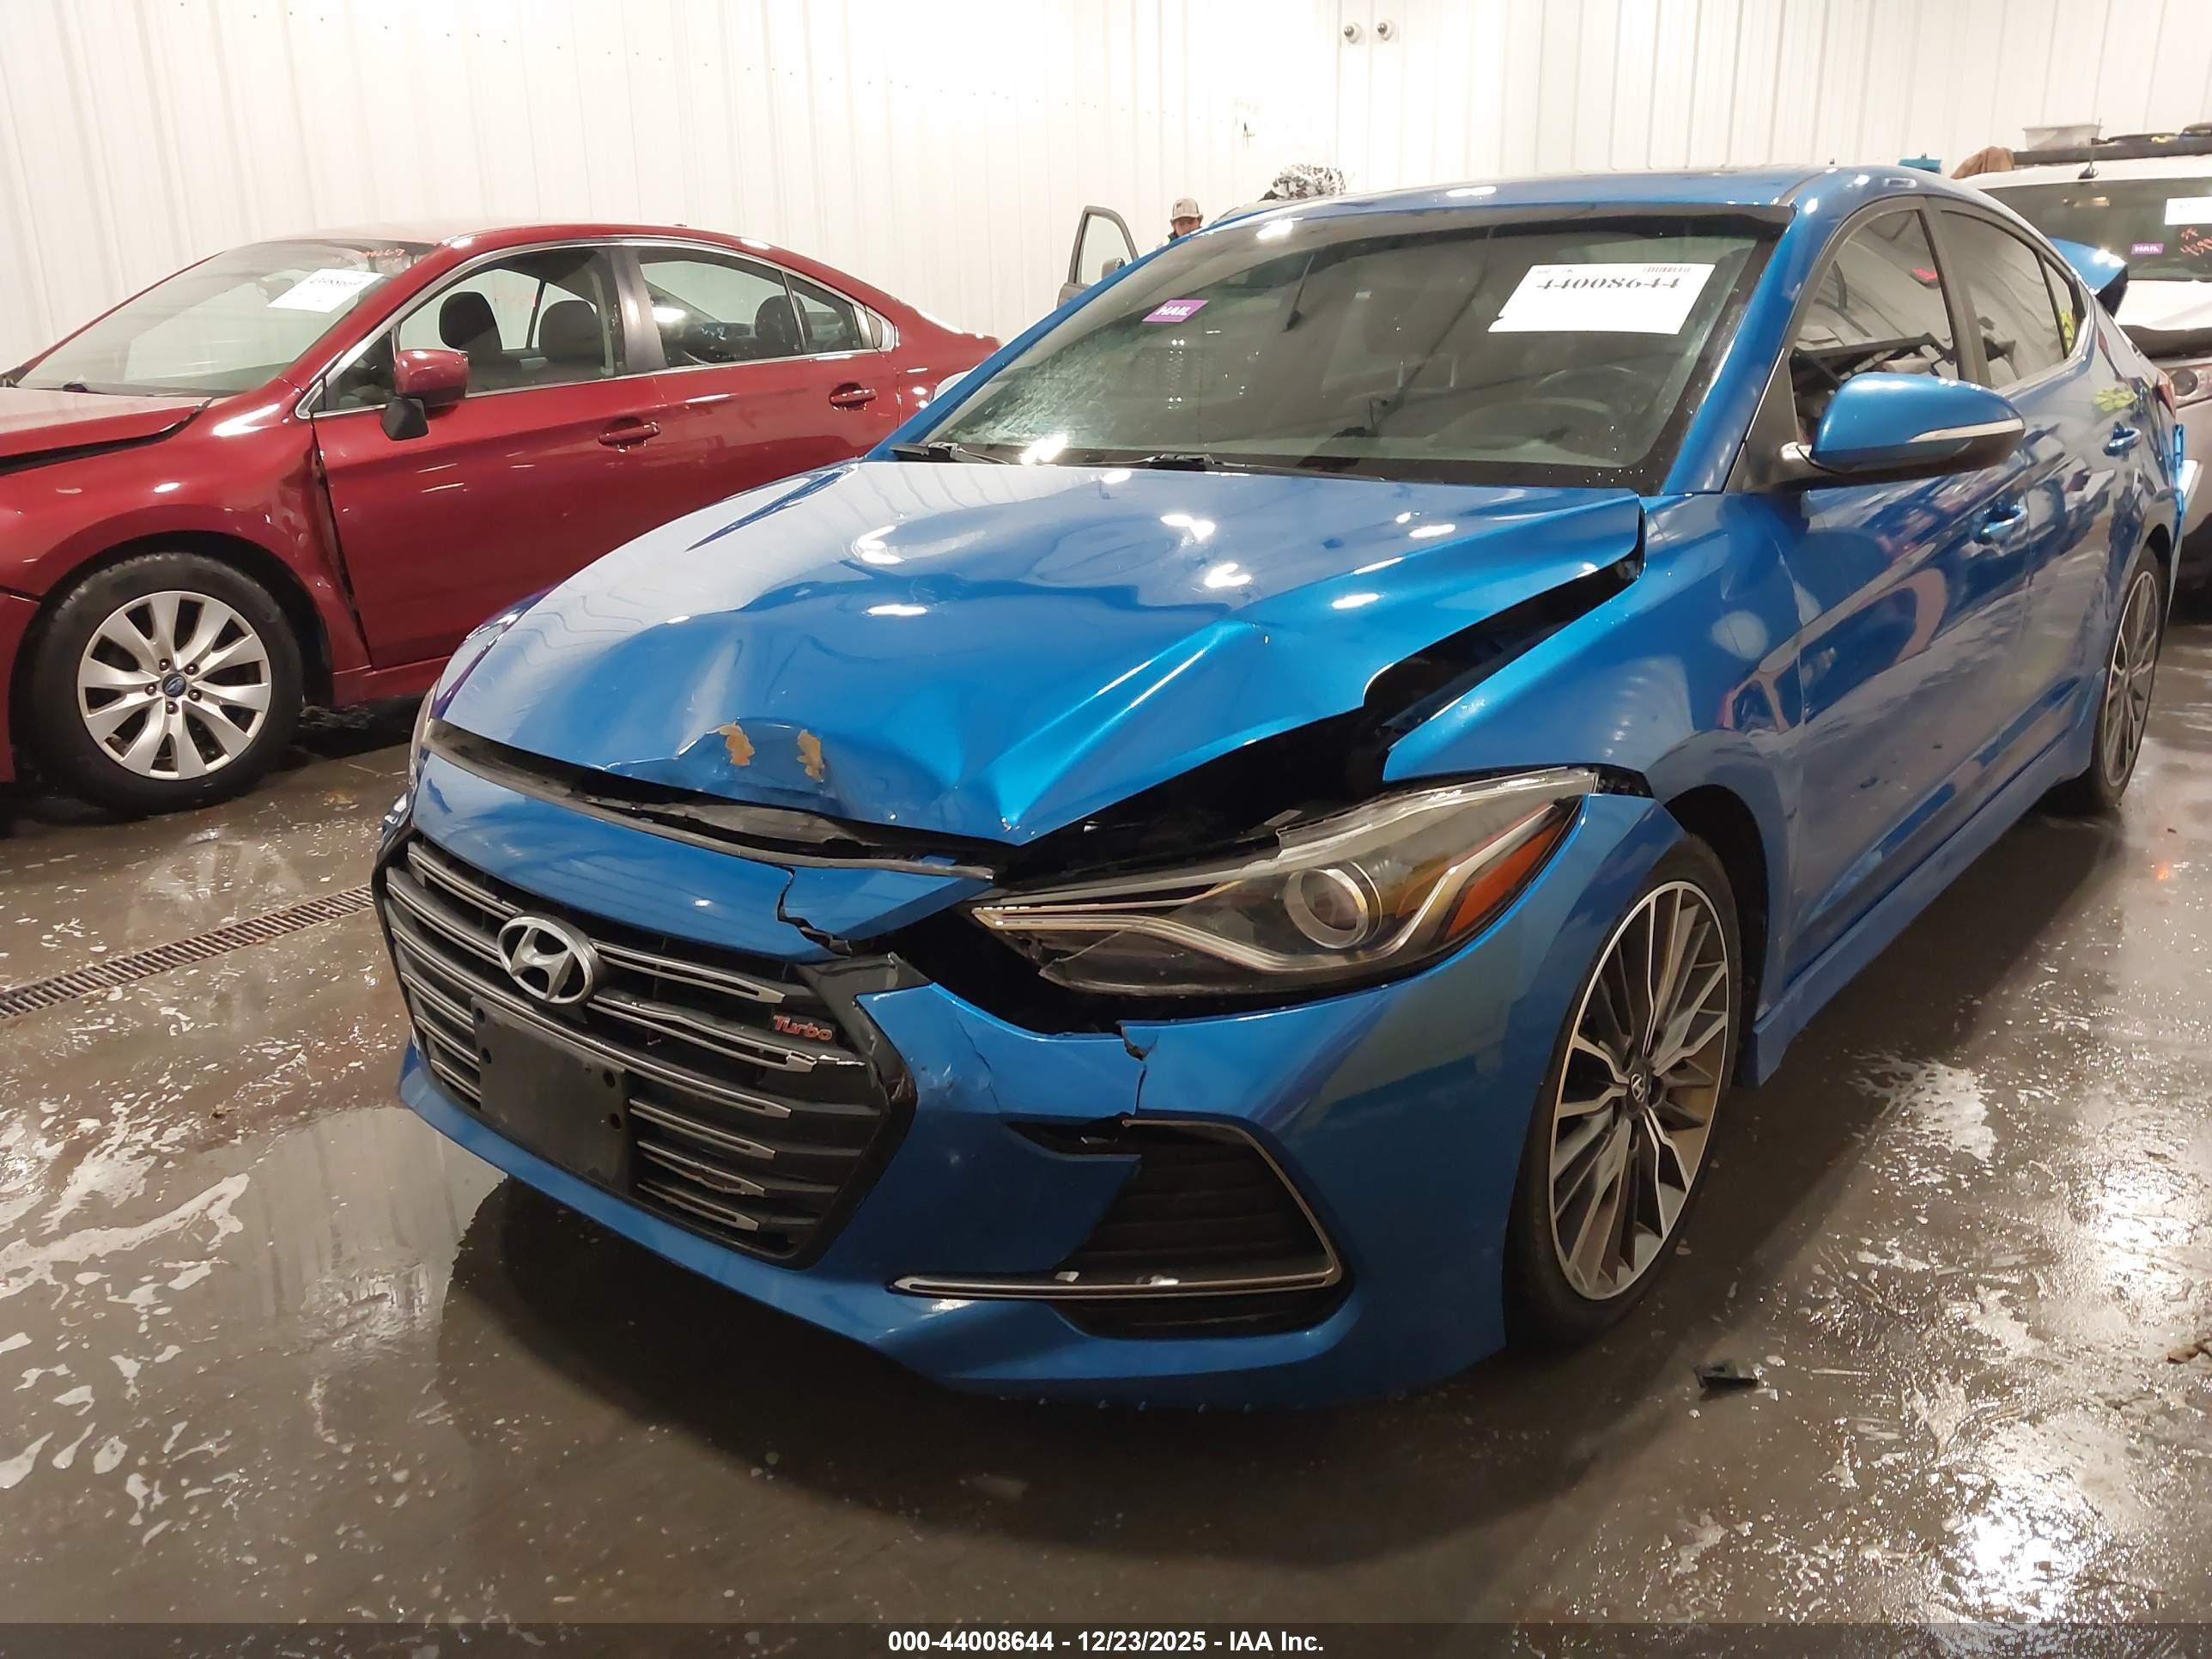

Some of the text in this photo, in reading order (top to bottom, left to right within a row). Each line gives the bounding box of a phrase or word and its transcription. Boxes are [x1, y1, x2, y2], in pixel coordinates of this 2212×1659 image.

[2135, 245, 2159, 253] HAIL
[1535, 276, 1680, 290] 44008644
[1155, 306, 1192, 316] HAIL
[773, 1015, 833, 1042] Turbo
